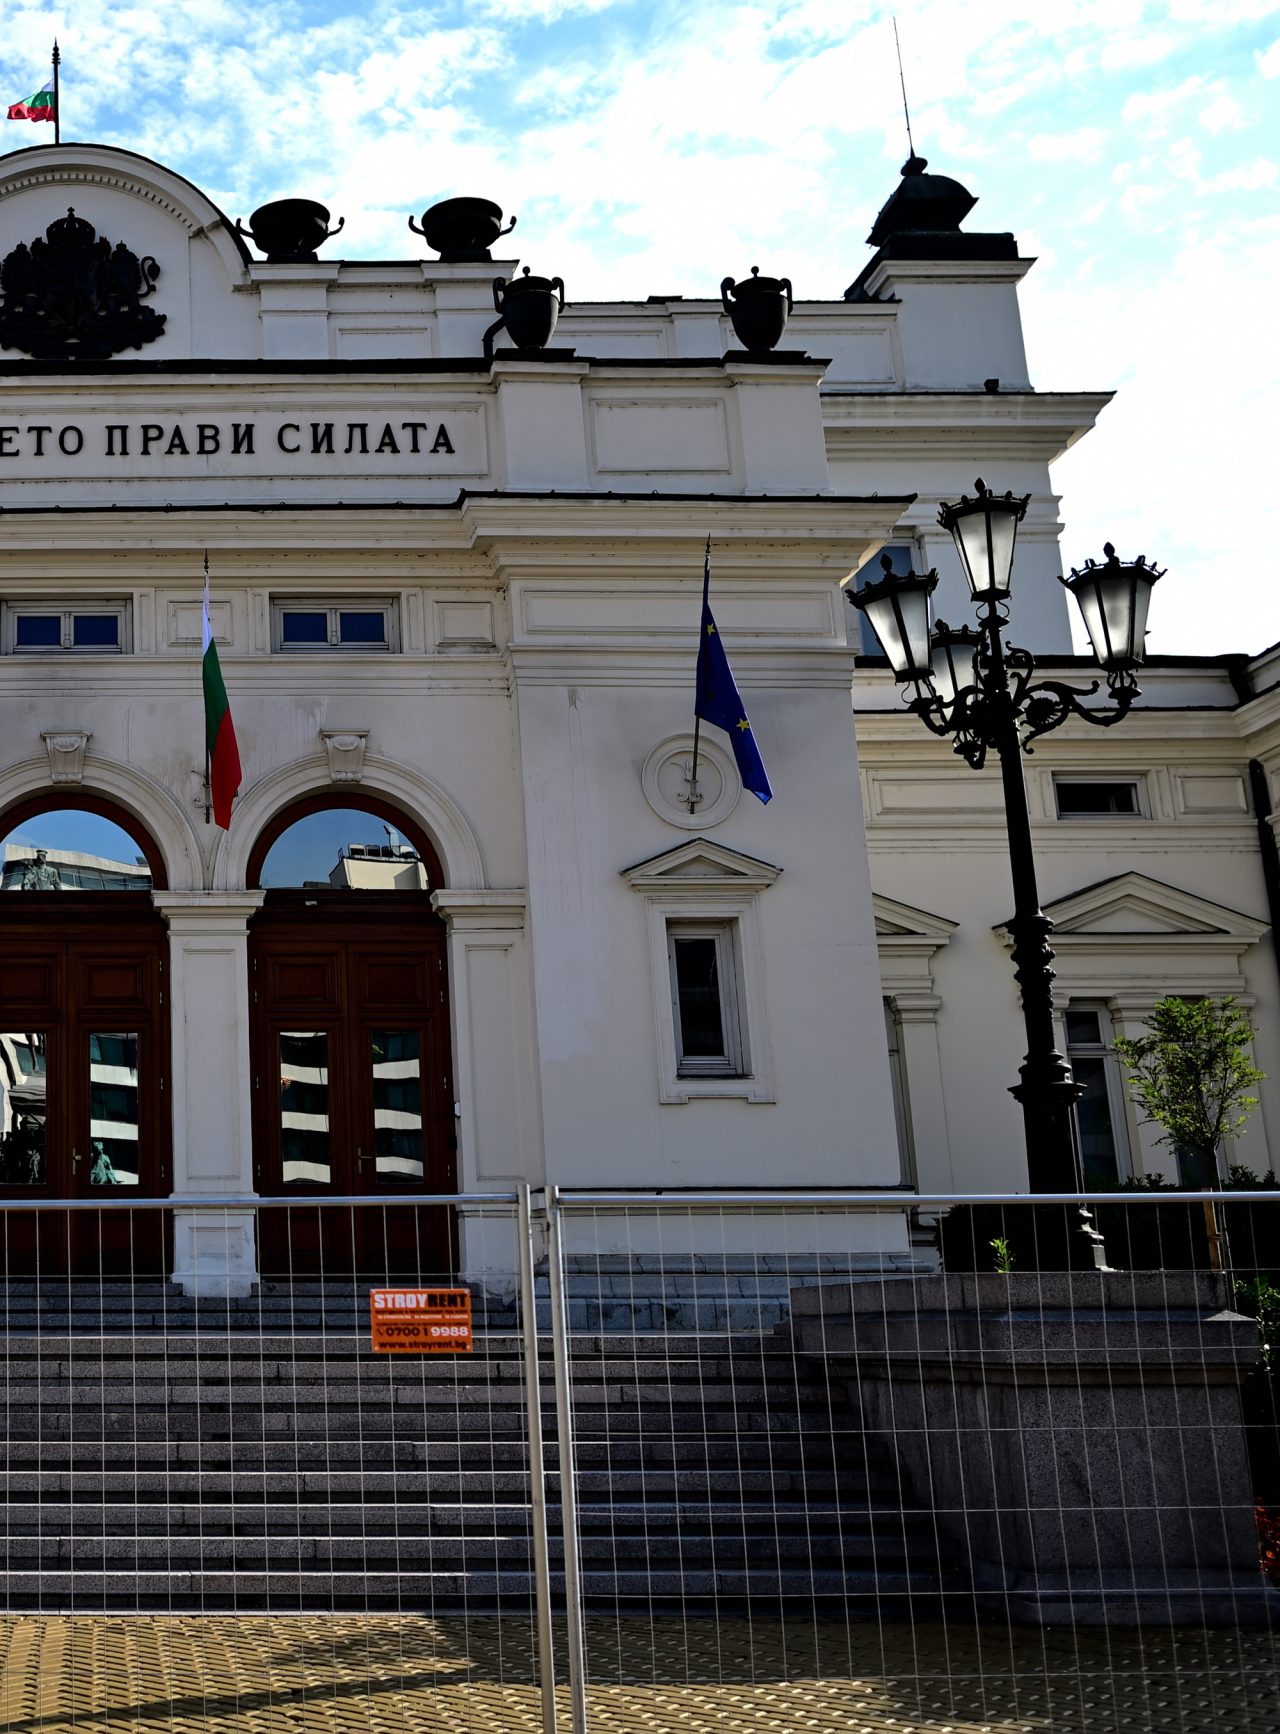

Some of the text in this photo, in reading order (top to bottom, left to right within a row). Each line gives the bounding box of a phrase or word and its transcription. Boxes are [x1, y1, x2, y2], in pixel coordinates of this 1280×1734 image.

[104, 423, 255, 456] ПРАВИ
[276, 422, 455, 454] СИЛАТА
[374, 1293, 466, 1309] STROYRENT
[385, 1327, 420, 1337] 0700
[378, 1341, 467, 1350] www.stroyrent.bg
